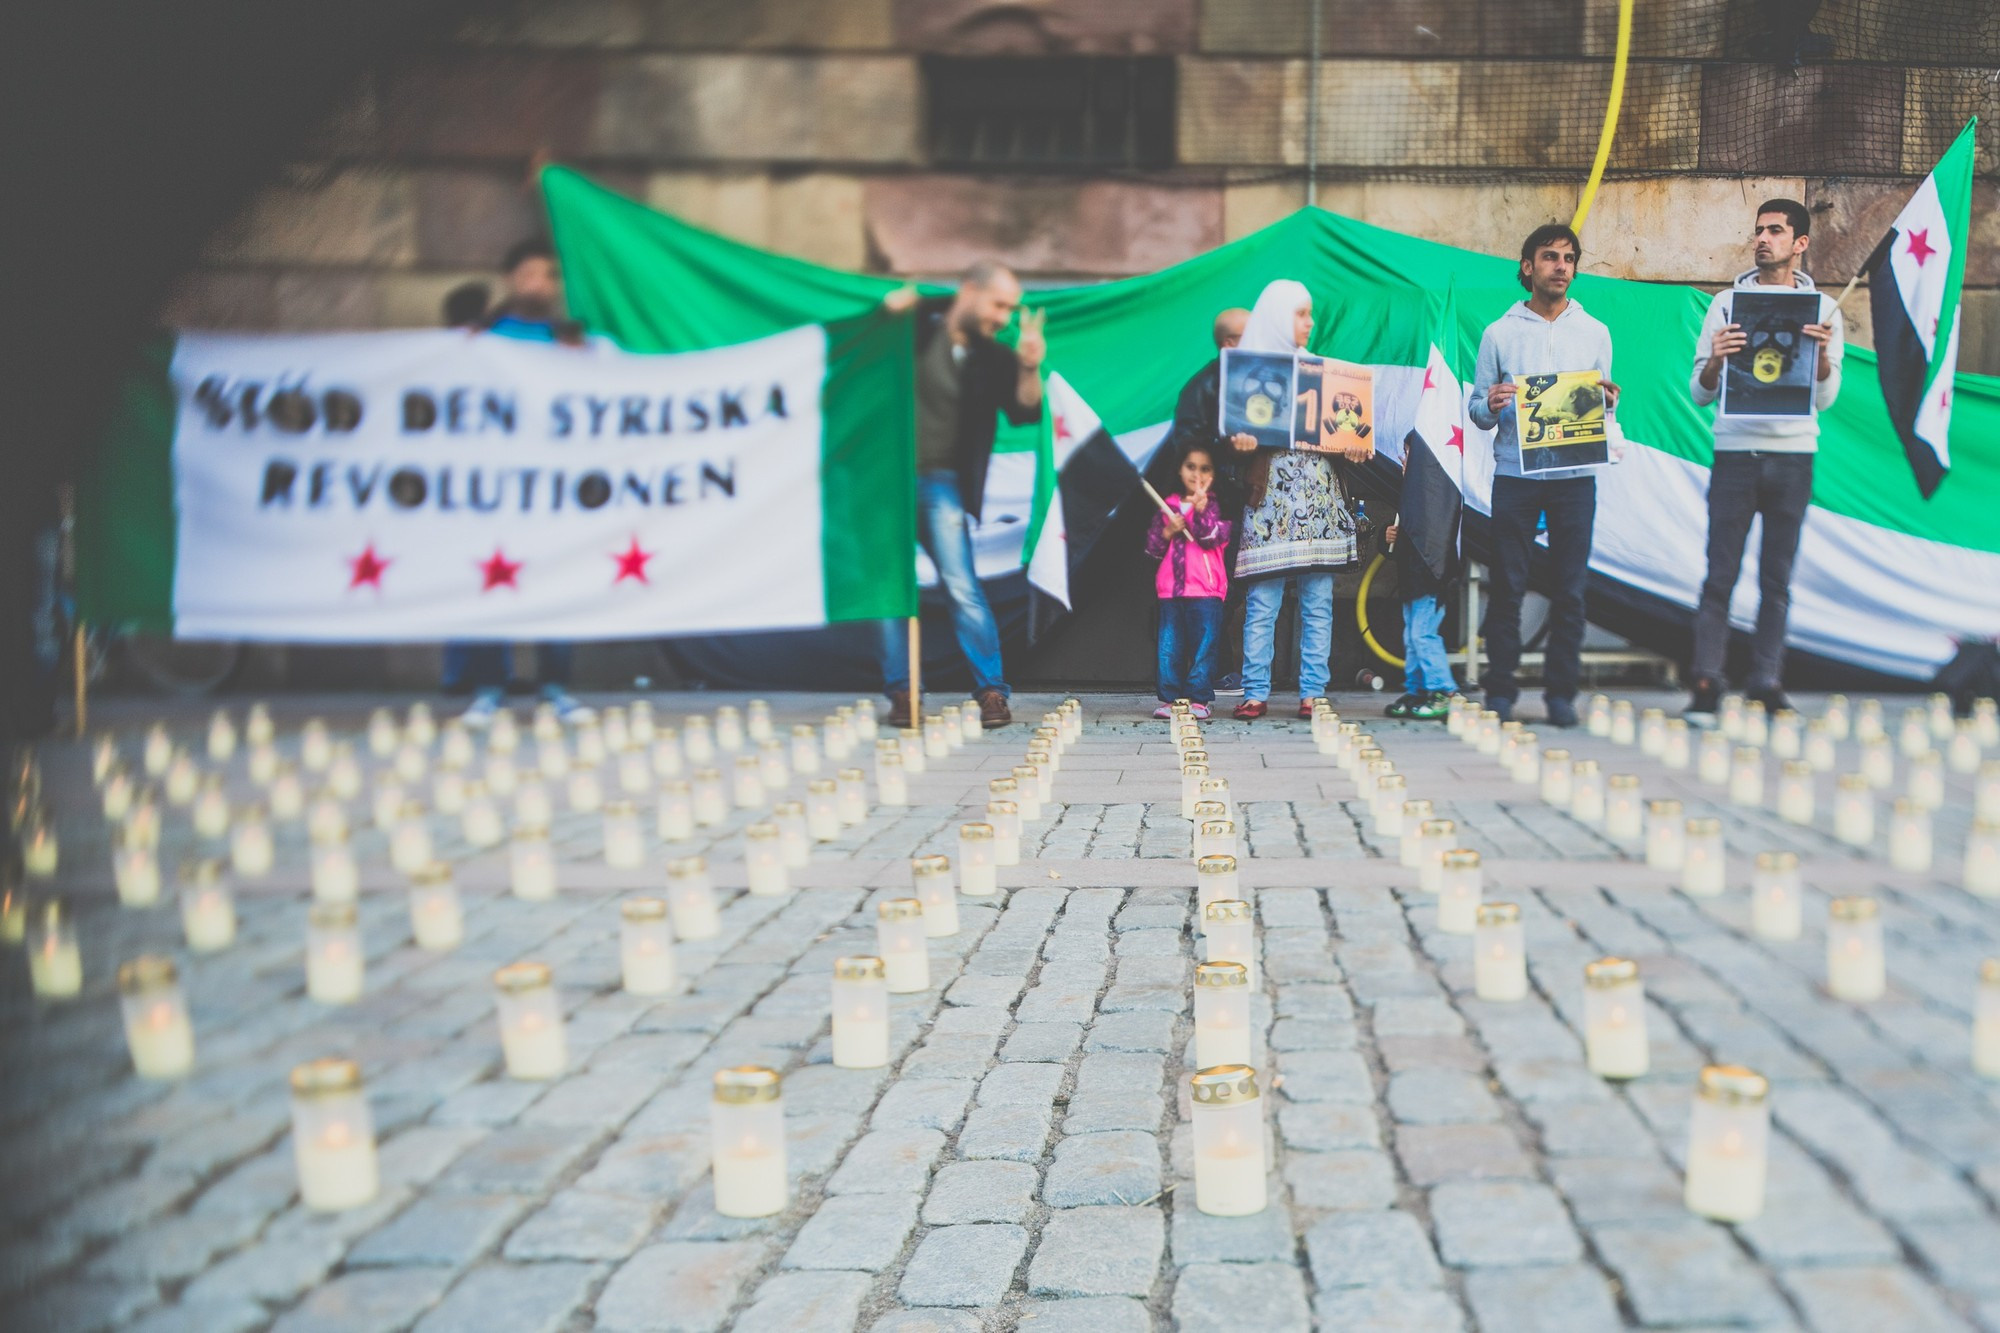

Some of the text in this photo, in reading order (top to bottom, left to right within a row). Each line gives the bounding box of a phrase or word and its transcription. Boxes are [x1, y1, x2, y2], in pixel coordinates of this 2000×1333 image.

[193, 372, 788, 437] STÖD DEN SYRISKA
[260, 456, 736, 512] REVOLUTIONEN
